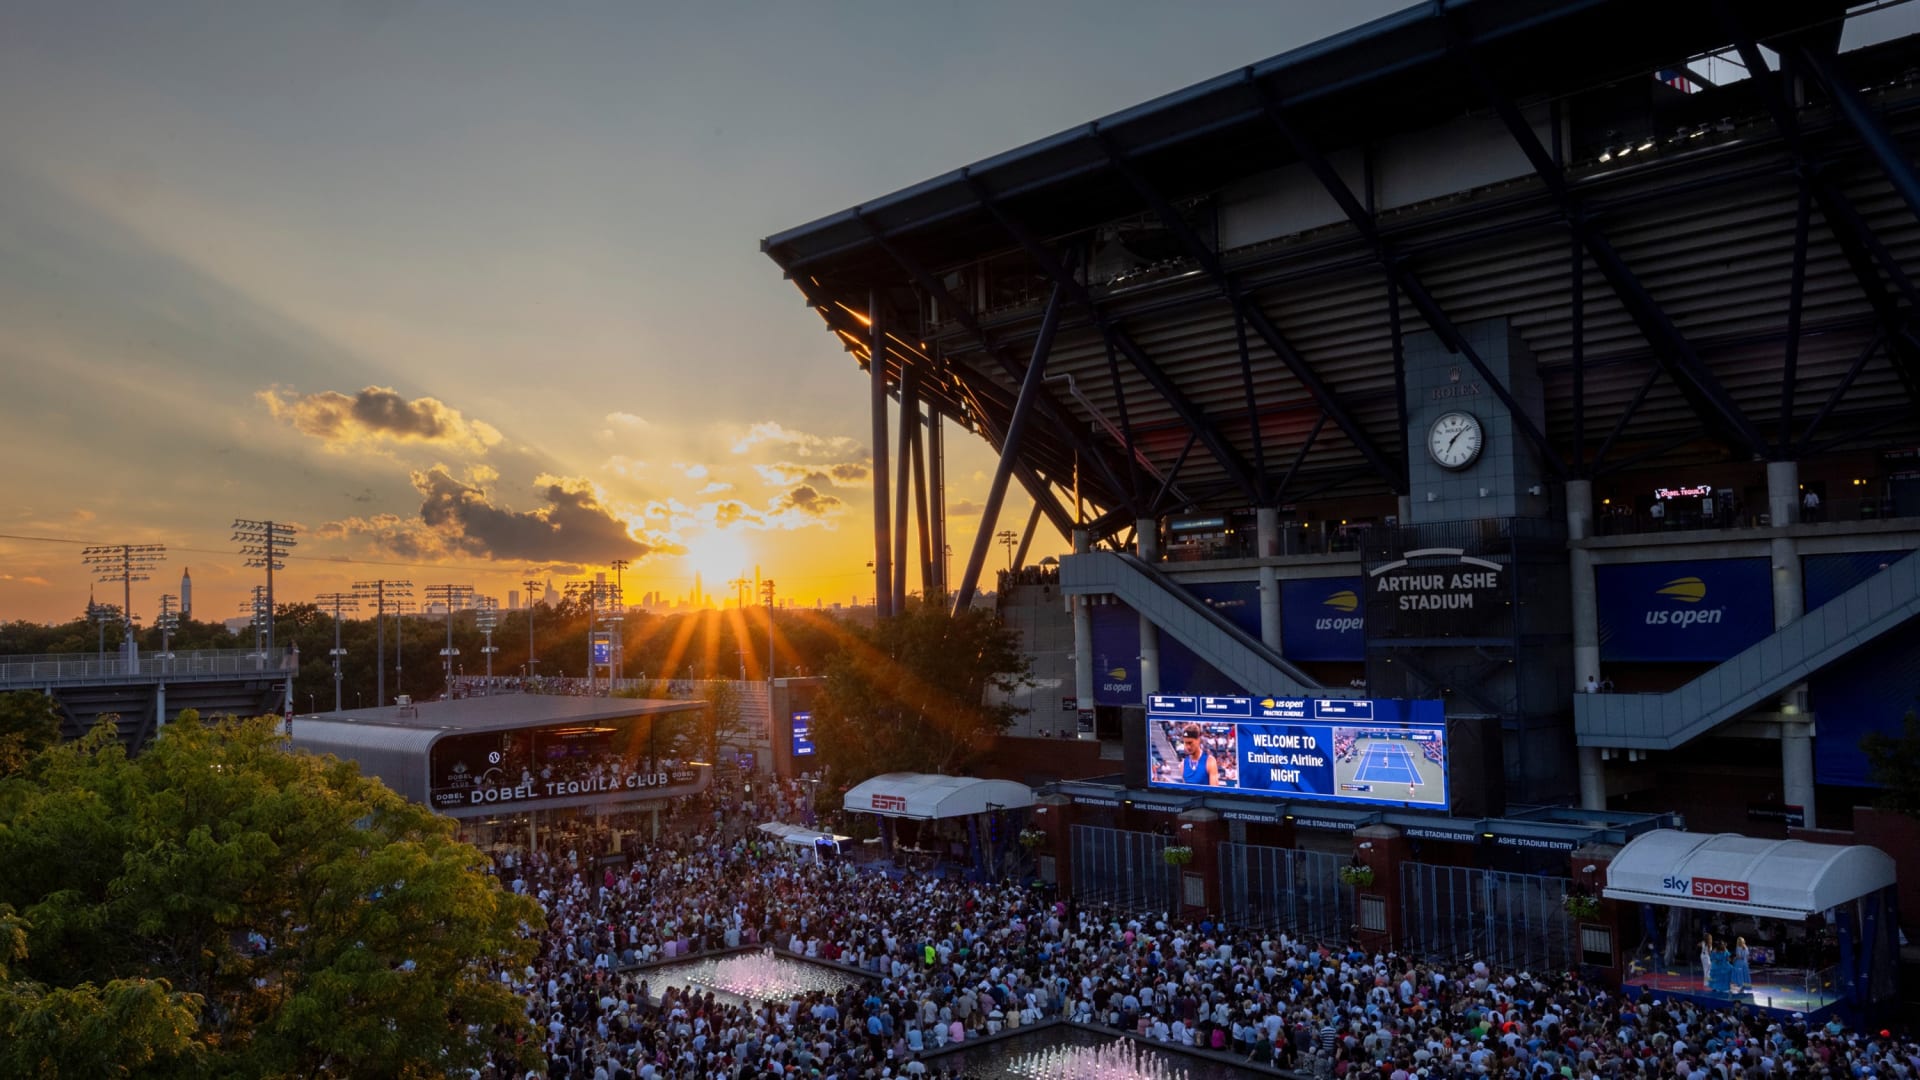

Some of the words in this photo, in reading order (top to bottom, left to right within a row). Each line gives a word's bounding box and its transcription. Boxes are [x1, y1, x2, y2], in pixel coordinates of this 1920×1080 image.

[1432, 383, 1480, 400] ROLEX
[1377, 574, 1445, 592] ARTHUR
[1450, 571, 1498, 589] ASHE
[1399, 592, 1474, 611] STADIUM
[1315, 617, 1333, 630] us
[1645, 610, 1669, 625] us
[1670, 608, 1722, 629] open
[1103, 683, 1113, 691] us
[1112, 683, 1132, 694] open
[1276, 700, 1285, 708] us
[1285, 700, 1304, 710] open
[1253, 733, 1301, 749] WELCOME
[1301, 736, 1316, 750] TO
[1247, 751, 1288, 765] Emirates
[1290, 753, 1324, 767] Airline
[1271, 768, 1301, 783] NIGHT
[471, 784, 538, 804] DOBEL
[546, 776, 620, 795] TEQUILA
[626, 772, 668, 788] CLUB
[436, 792, 464, 801] DOBEL
[871, 794, 906, 812] ESPN
[1223, 811, 1237, 819] ASHE
[1238, 813, 1261, 822] STADIUM
[1296, 818, 1312, 827] ASHE
[1312, 820, 1337, 829] STADIUM
[1407, 828, 1424, 837] ASHE
[1424, 830, 1453, 839] STADIUM
[1453, 832, 1475, 841] ENTRY
[1498, 836, 1517, 845] ASHE
[1517, 838, 1548, 848] STADIUM
[1549, 841, 1572, 850] ENTRY
[1663, 876, 1689, 893] sky
[1694, 881, 1746, 897] sports
